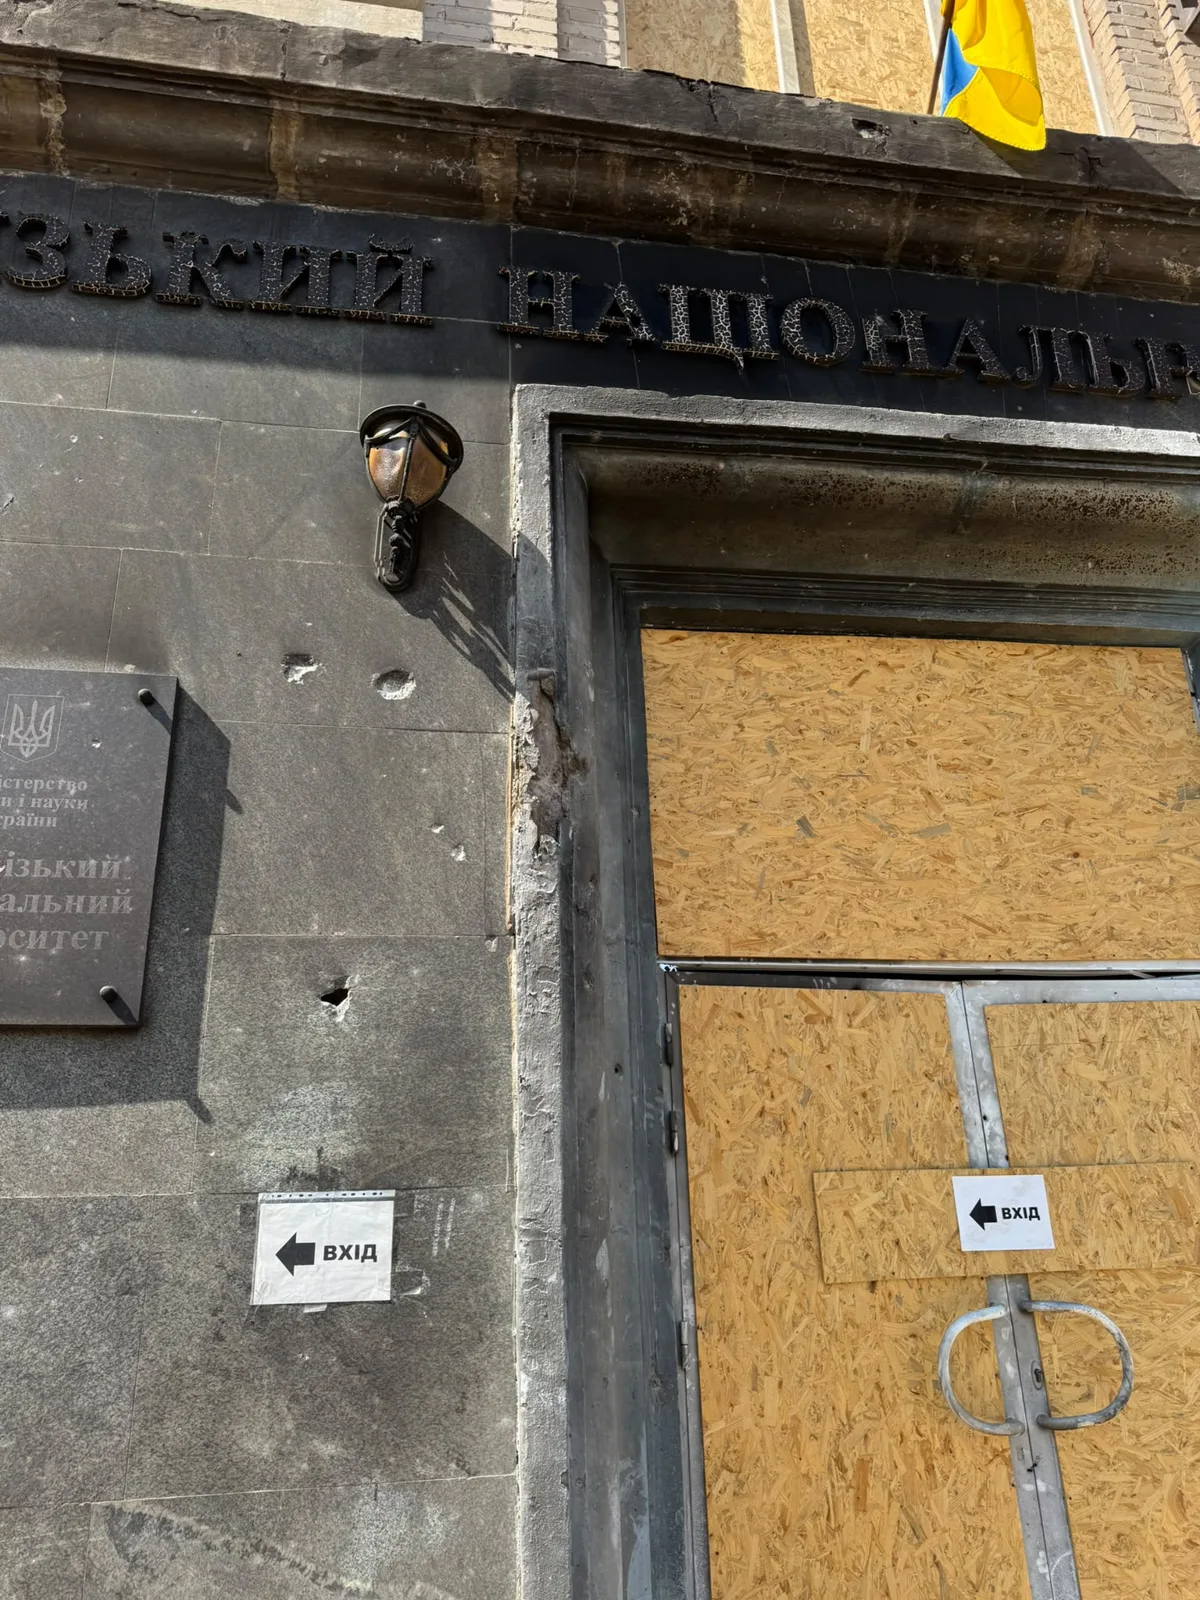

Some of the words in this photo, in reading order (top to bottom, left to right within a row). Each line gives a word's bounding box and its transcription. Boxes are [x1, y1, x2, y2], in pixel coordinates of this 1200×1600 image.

[0, 209, 433, 326] ЗЬКИЙ
[19, 793, 26, 808] і
[31, 797, 89, 812] науки
[0, 888, 132, 914] альний
[1001, 1206, 1040, 1221] ВХІД
[323, 1244, 377, 1263] ВХІД
